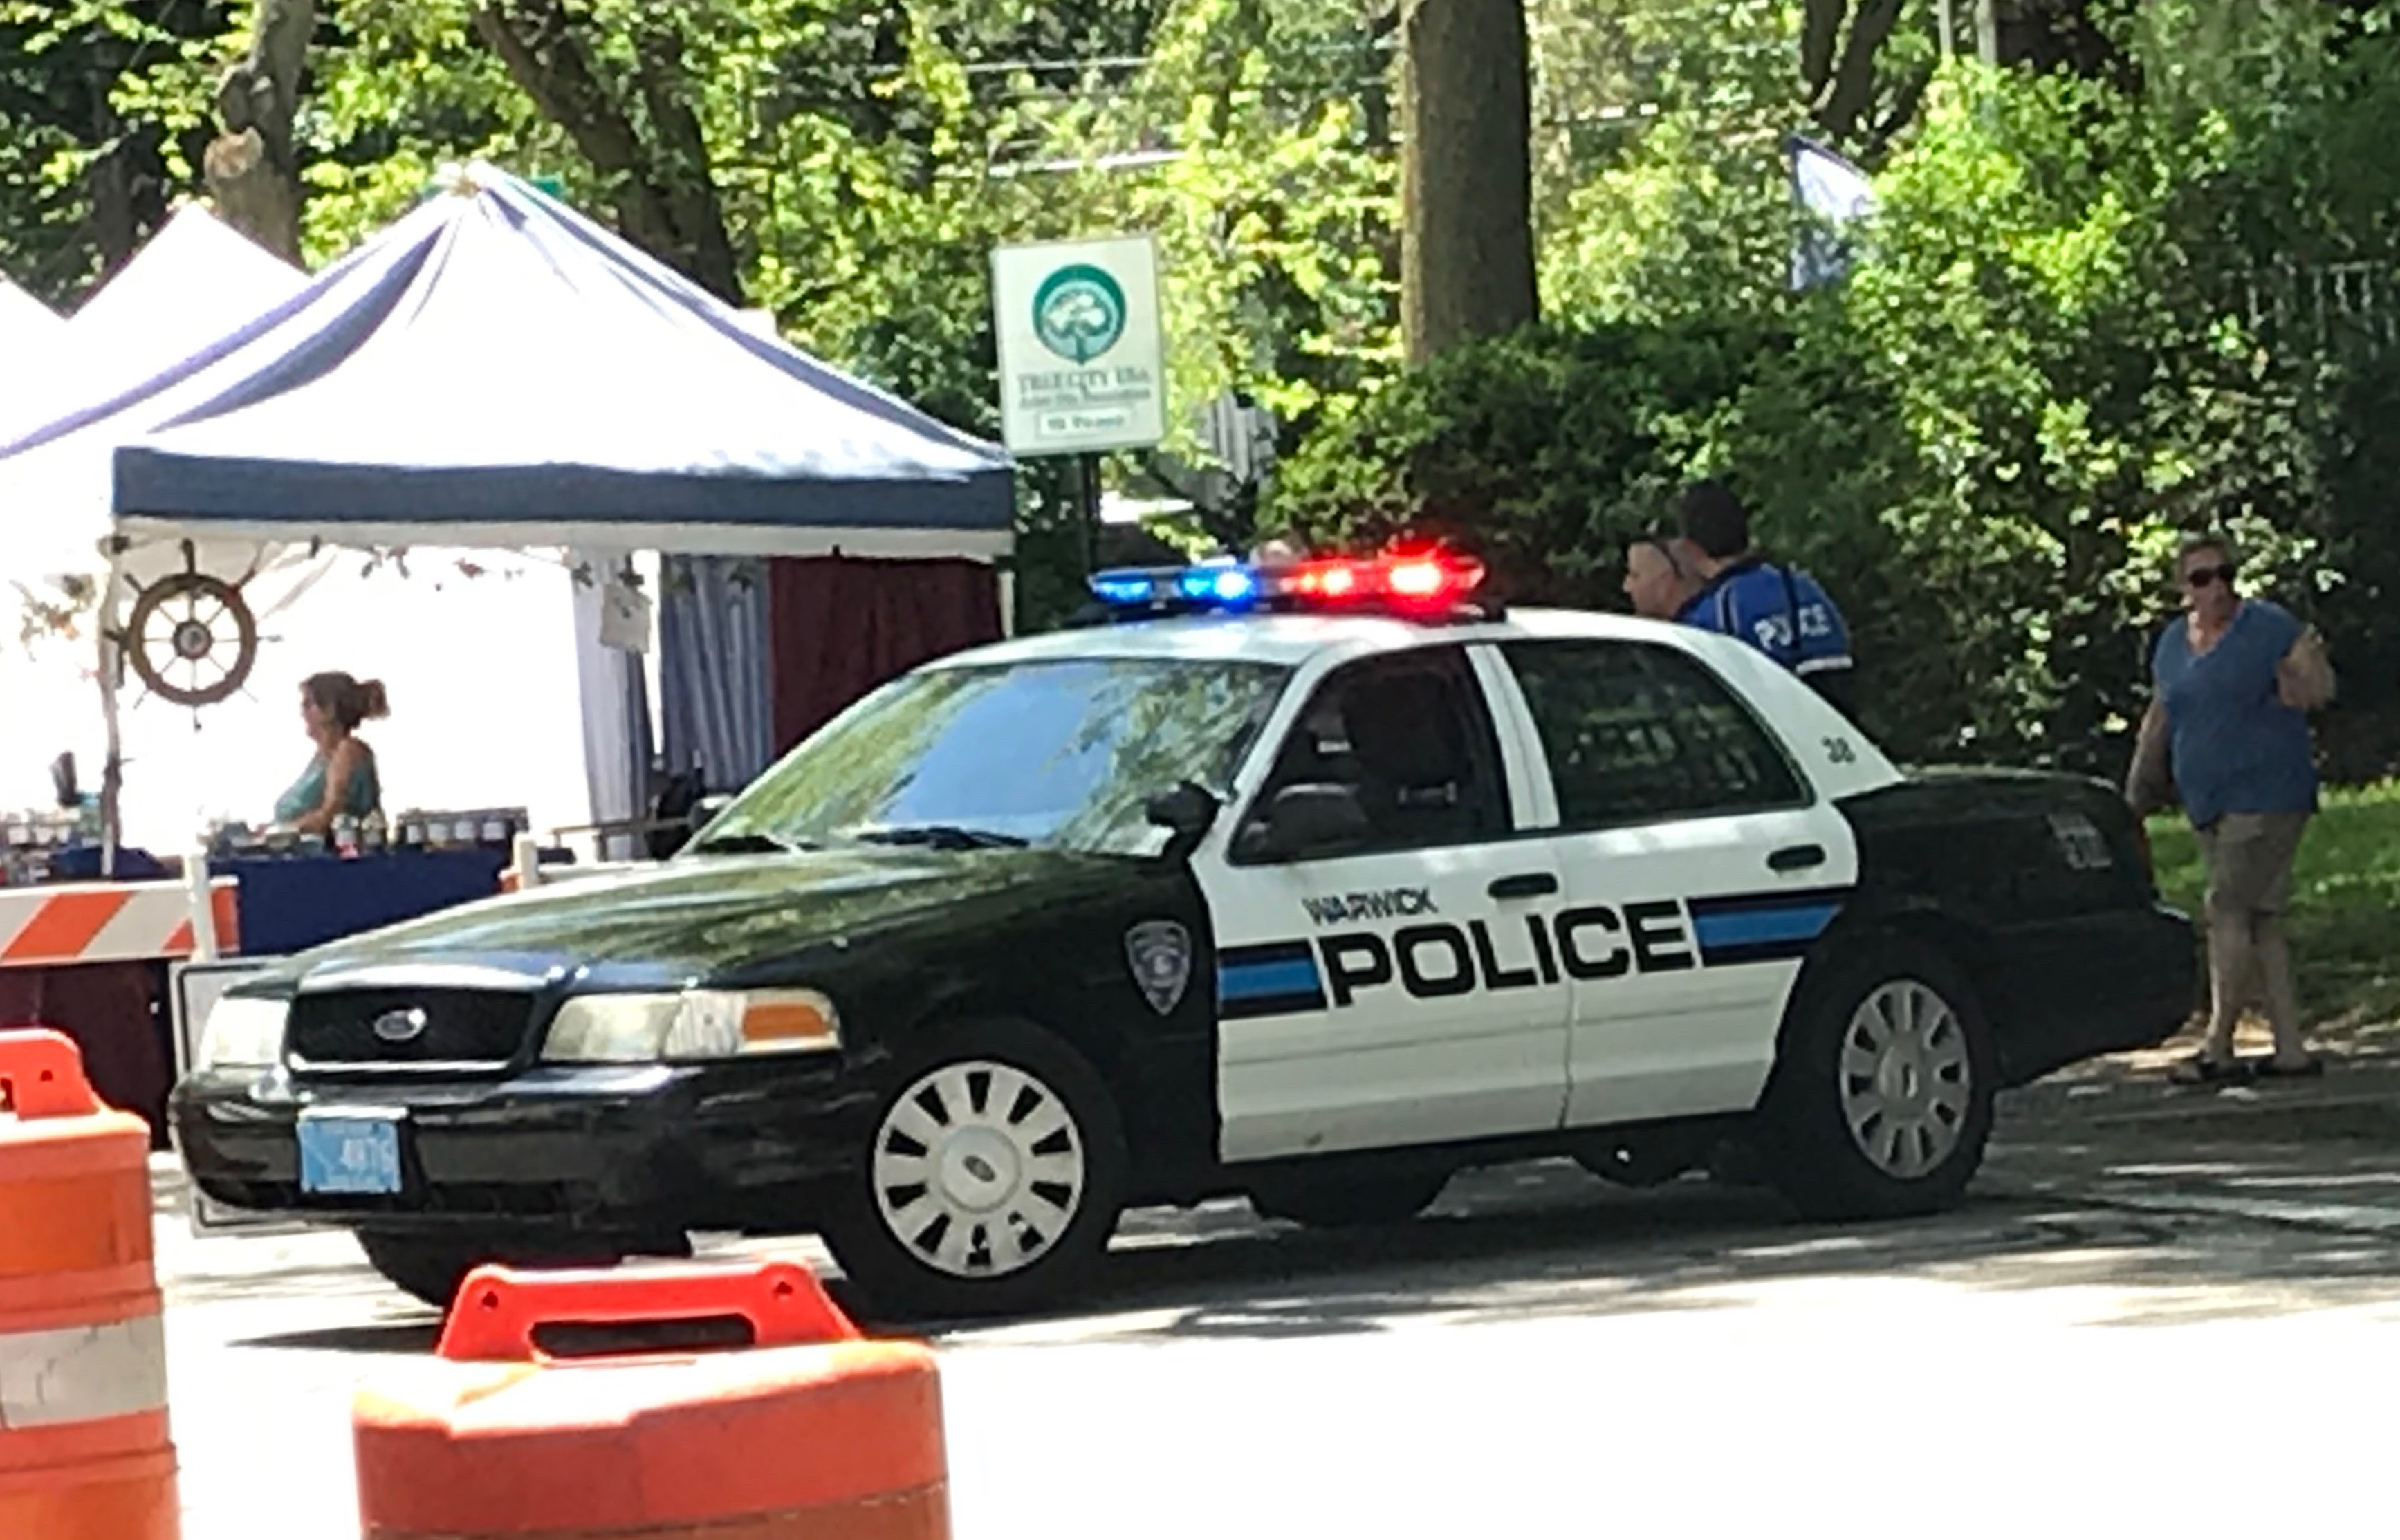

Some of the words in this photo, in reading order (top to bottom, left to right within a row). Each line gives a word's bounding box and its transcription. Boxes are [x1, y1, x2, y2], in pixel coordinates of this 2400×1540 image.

[1754, 603, 1830, 650] POCE
[1302, 887, 1439, 926] WARWICK
[1318, 899, 1695, 1008] POLICE
